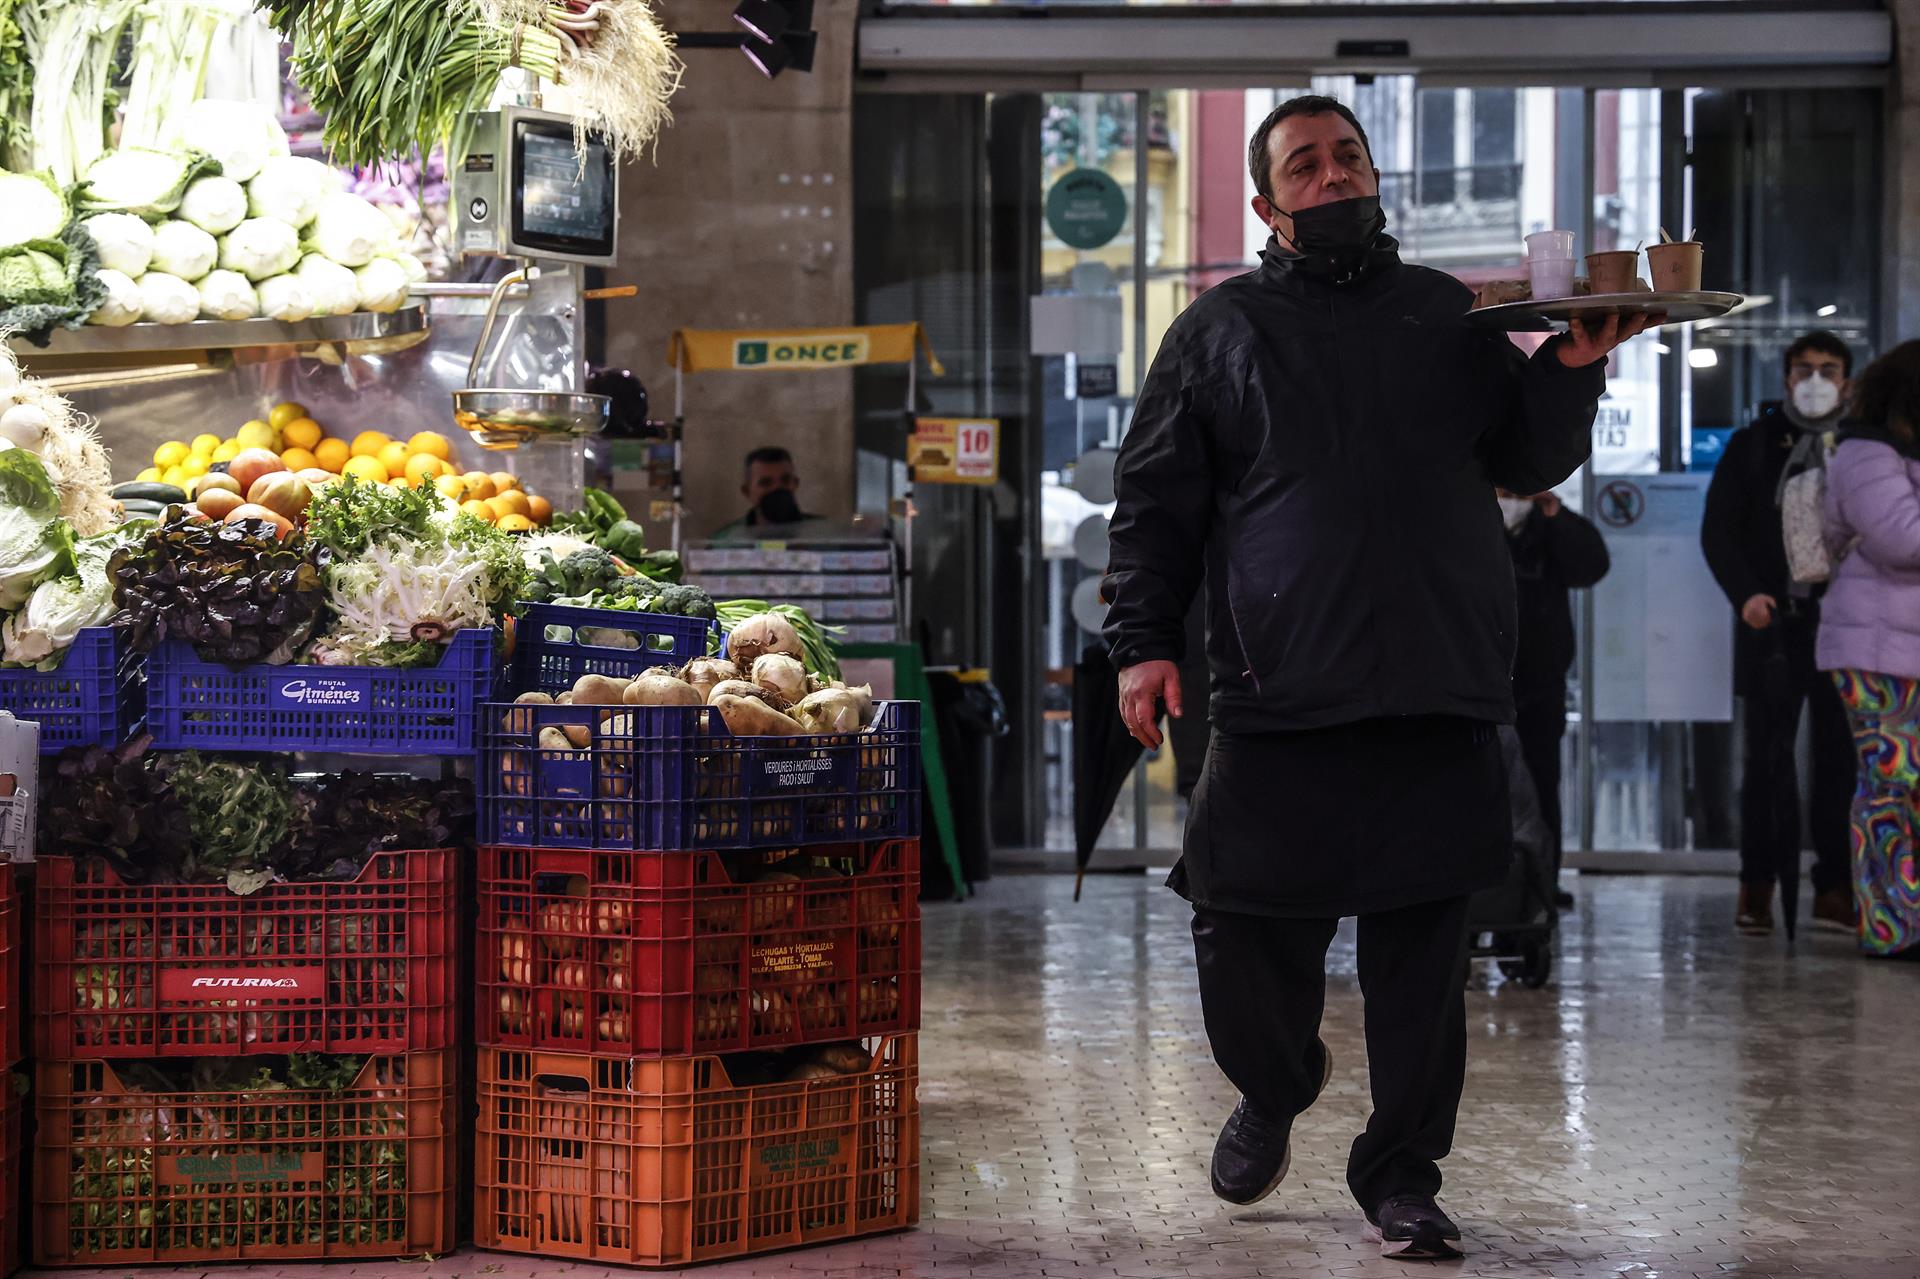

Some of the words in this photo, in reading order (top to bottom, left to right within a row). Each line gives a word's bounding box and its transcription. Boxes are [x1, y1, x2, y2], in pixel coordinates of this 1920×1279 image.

[775, 343, 857, 361] ONCE
[962, 430, 989, 453] 10
[764, 761, 793, 774] VERDURES
[796, 758, 832, 771] HORTALISSES
[779, 774, 793, 786] PACO
[797, 772, 815, 784] SALUT
[751, 946, 788, 957] LECHUGAS
[789, 946, 794, 954] Y
[795, 942, 834, 953] HORTALIZAS
[764, 956, 794, 966] VELARTE
